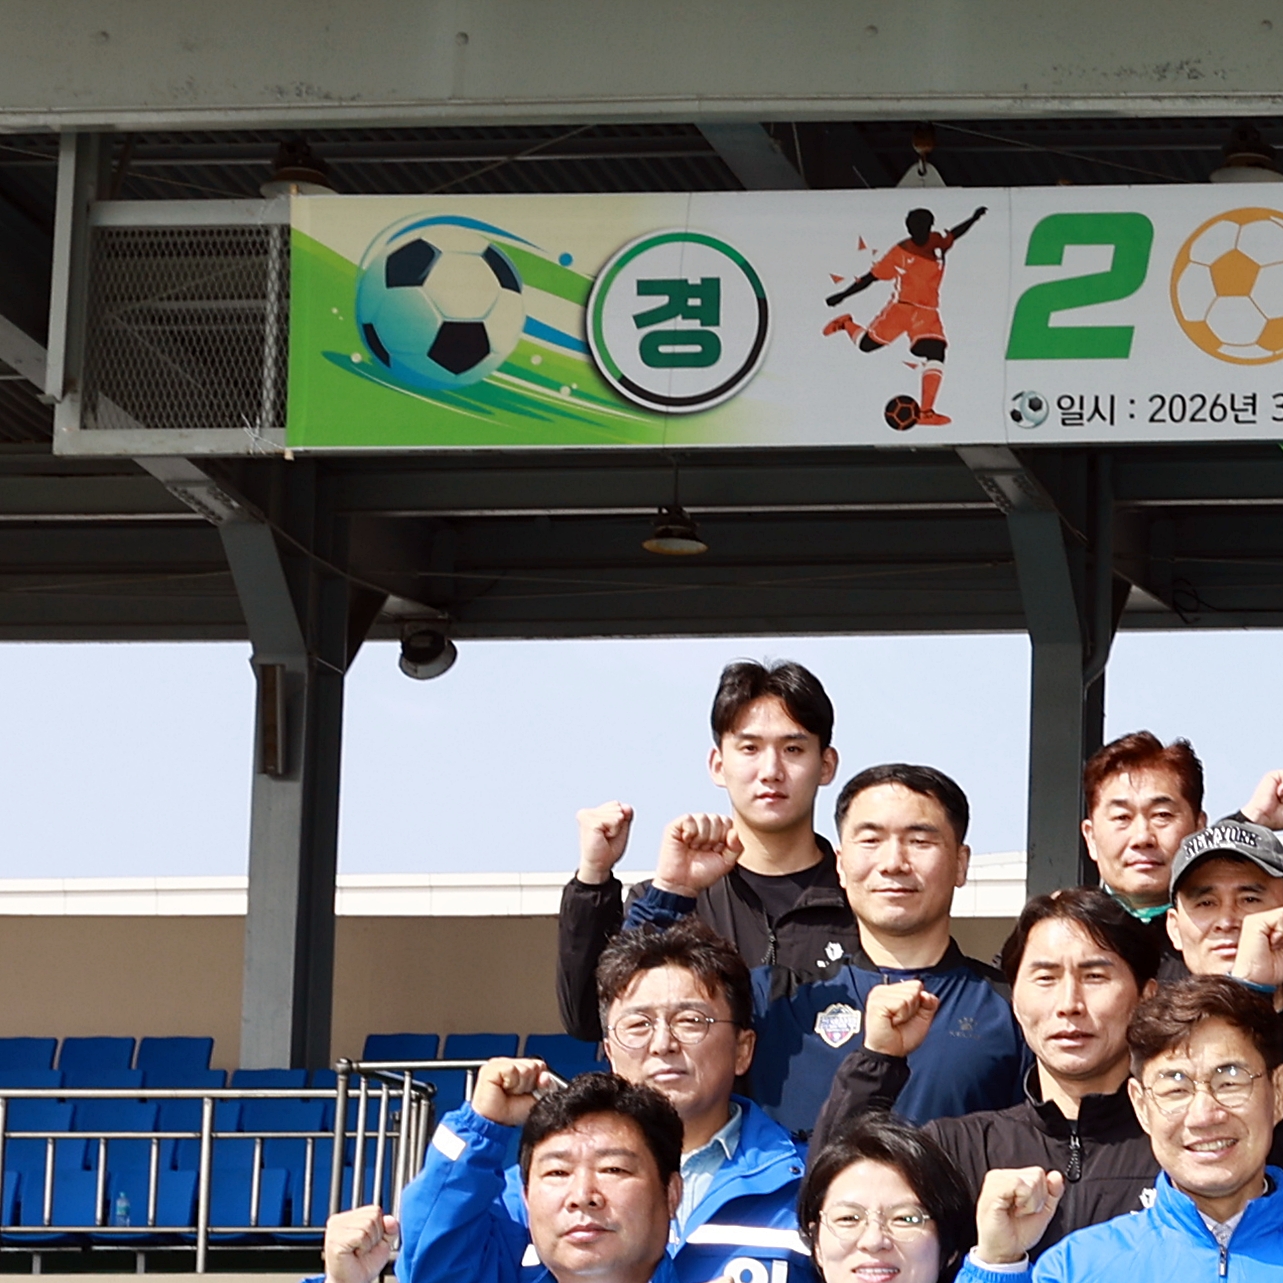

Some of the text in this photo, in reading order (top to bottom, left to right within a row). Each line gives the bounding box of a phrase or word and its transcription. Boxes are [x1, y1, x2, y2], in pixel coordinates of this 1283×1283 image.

[632, 276, 722, 369] 경
[1056, 393, 1117, 427] 일시
[1147, 391, 1259, 425] 2026년
